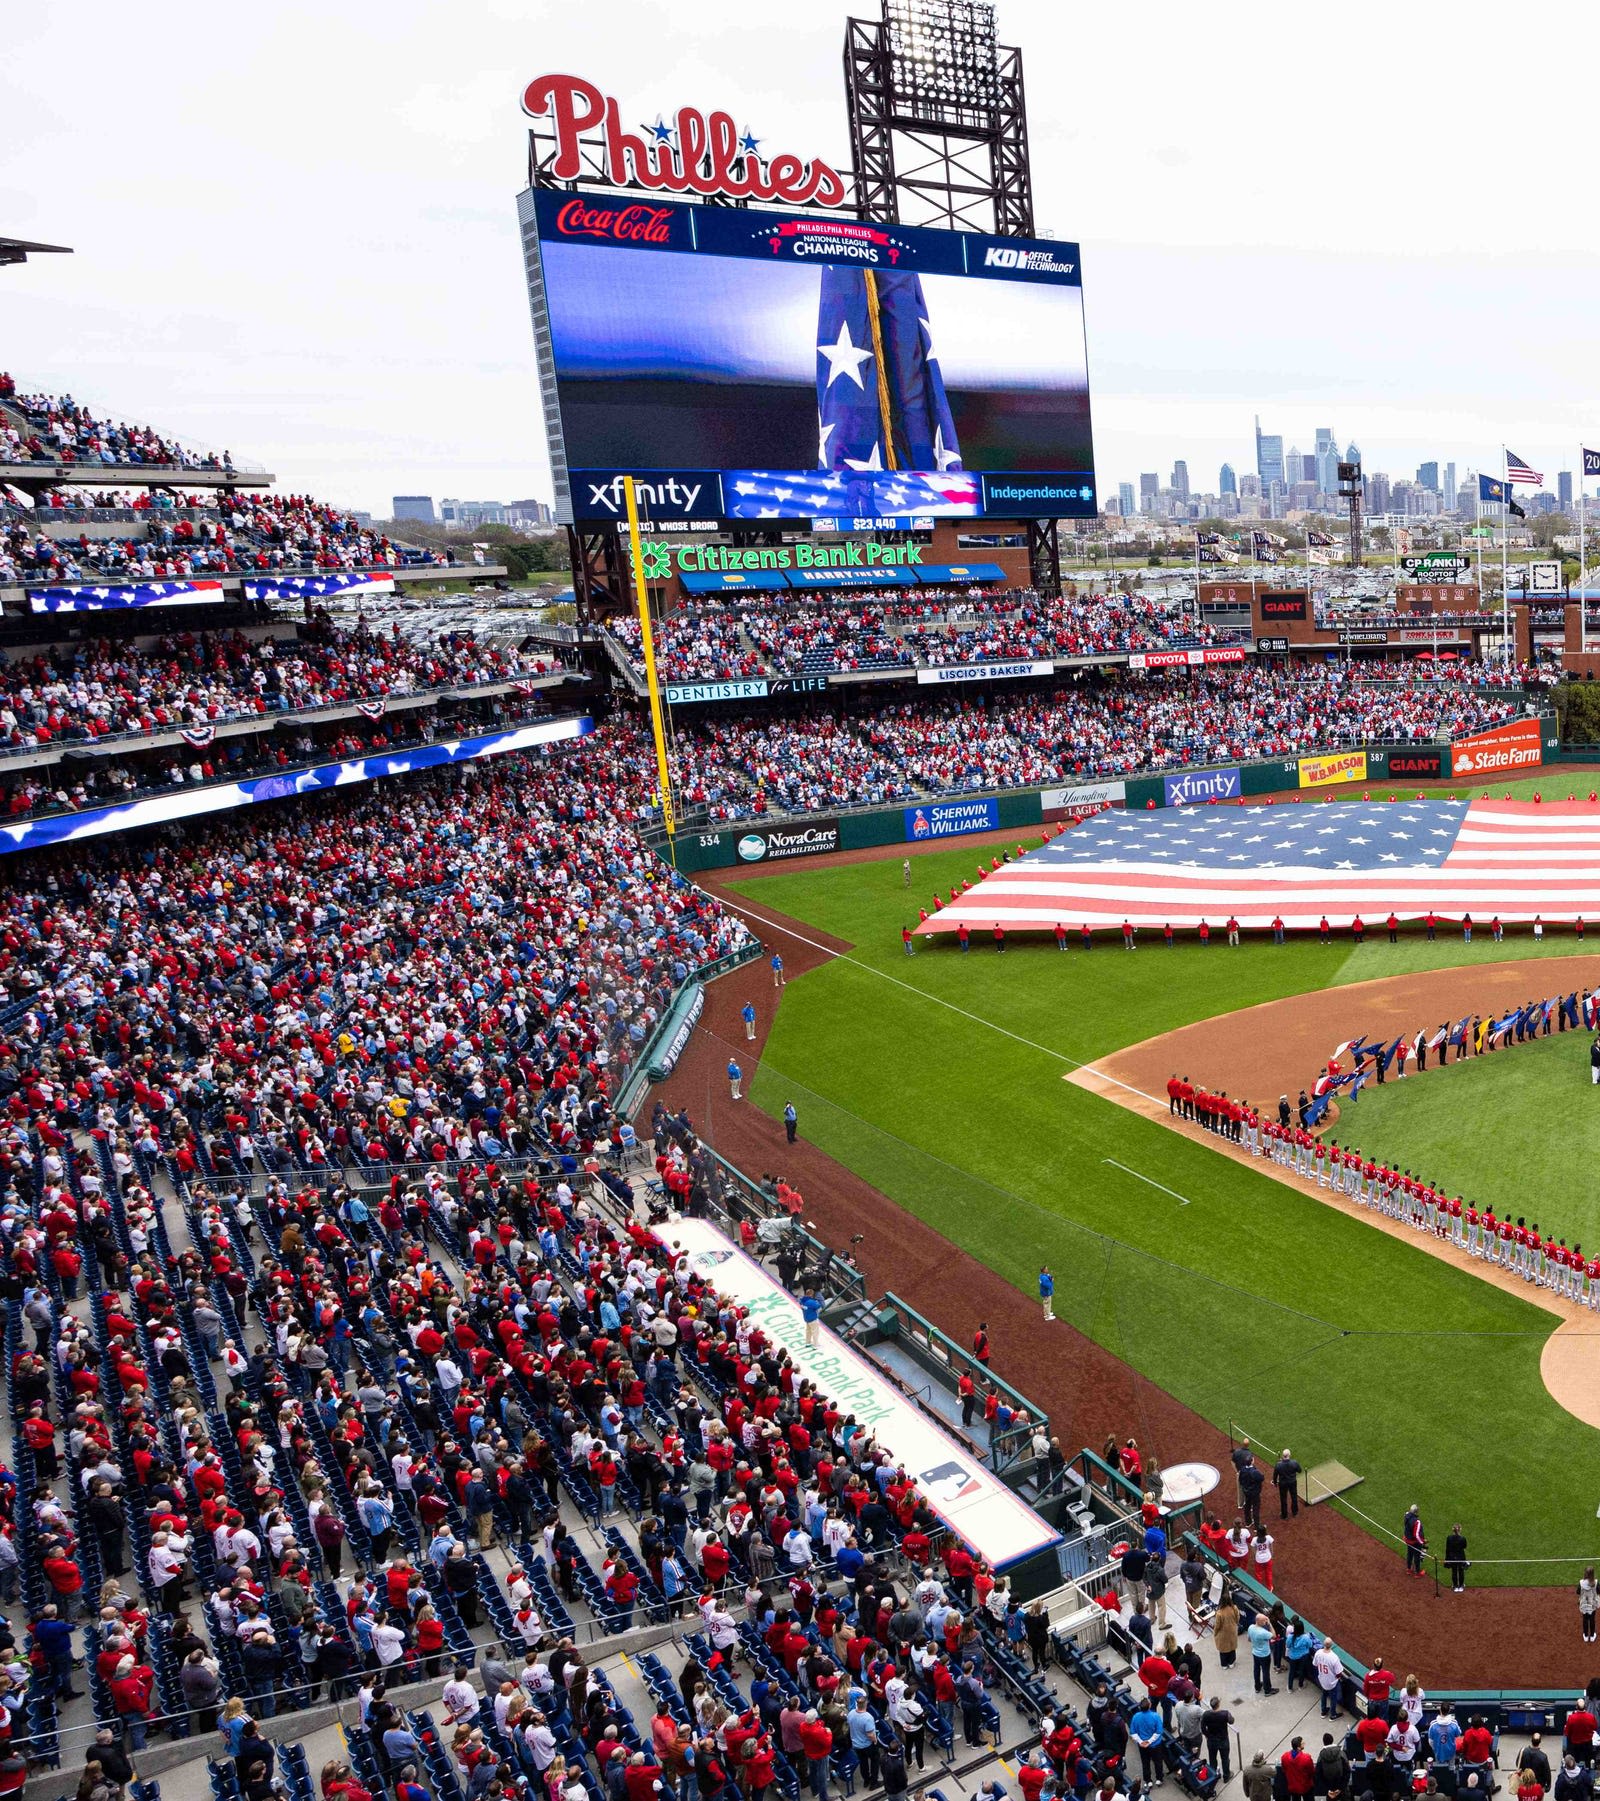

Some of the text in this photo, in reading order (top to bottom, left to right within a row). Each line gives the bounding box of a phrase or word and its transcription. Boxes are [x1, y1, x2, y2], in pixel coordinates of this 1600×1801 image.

[520, 72, 847, 207] Phillies
[556, 199, 674, 243] Coca-Cola
[797, 224, 871, 238] PHILADELPHIA PHILLIES
[803, 235, 868, 247] NATIONAL LEAGUE
[793, 241, 879, 263] CHAMPIONS
[1028, 251, 1054, 262] OFFICE
[1027, 260, 1075, 273] TECHNOLOGY
[588, 475, 702, 512] xfnity
[990, 486, 1077, 501] Independence
[659, 521, 688, 531] WHOSE
[853, 518, 896, 530] $23,440
[677, 539, 924, 571] Citizens Bank Park
[802, 570, 853, 580] HARRY
[1264, 602, 1303, 612] GIANT
[1147, 650, 1243, 665] TOYOTA TOYOTA
[938, 664, 1033, 680] LISCIO'S BAKERY
[667, 677, 827, 702] DENTISTRY for LIFE
[1547, 738, 1558, 747] 409
[1370, 753, 1384, 762] 387
[1389, 759, 1440, 771] GIANT
[1284, 763, 1297, 772] 374
[1058, 786, 1110, 805] Yuengling
[1170, 775, 1236, 803] xfinity
[931, 803, 988, 821] SHERWIN
[930, 817, 991, 833] WILLIAMS.
[699, 833, 721, 848] 334
[767, 828, 837, 848] NovaCare
[768, 841, 836, 858] REHABILITATION
[811, 1356, 863, 1394] Bank
[843, 1388, 896, 1425] Park
